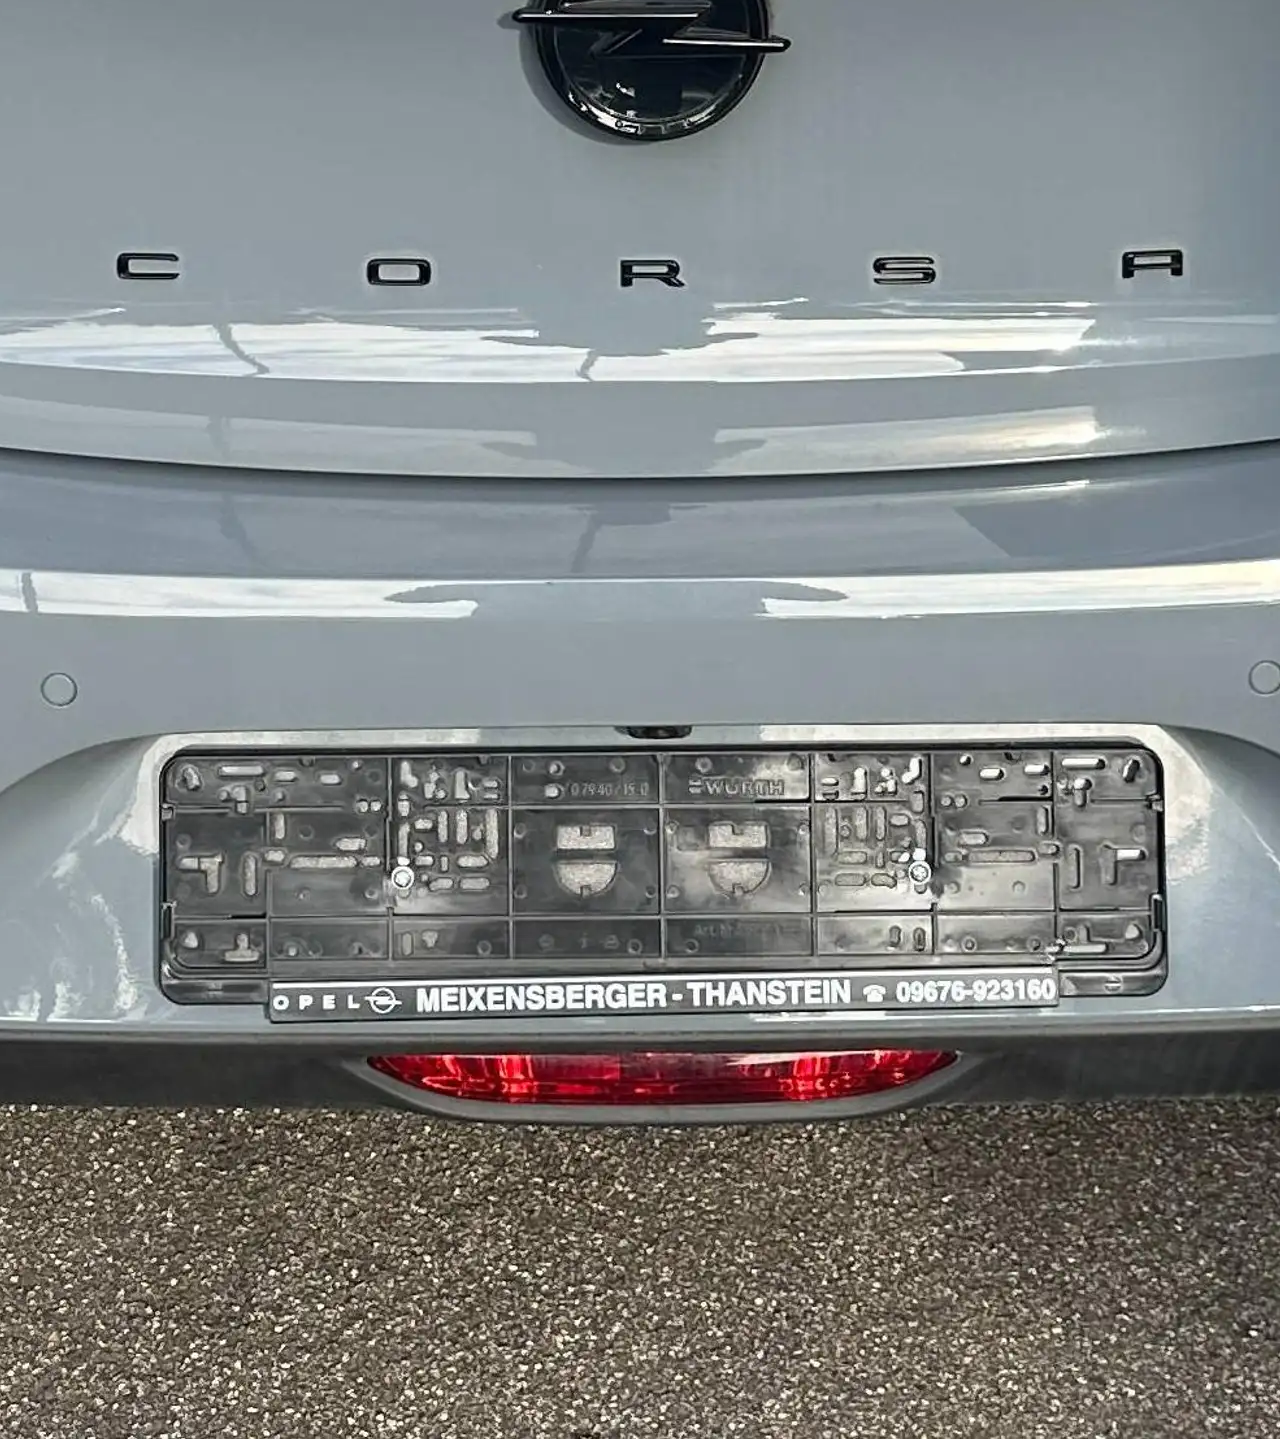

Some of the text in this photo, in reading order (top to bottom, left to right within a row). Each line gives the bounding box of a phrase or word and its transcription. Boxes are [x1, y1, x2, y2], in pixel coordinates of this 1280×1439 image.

[116, 249, 1185, 288] CORSA
[272, 994, 361, 1011] OPEL
[416, 983, 668, 1012] MEIXENSBERGER
[686, 978, 852, 1007] THANSTEIN
[895, 978, 1058, 1003] 09676-923160
